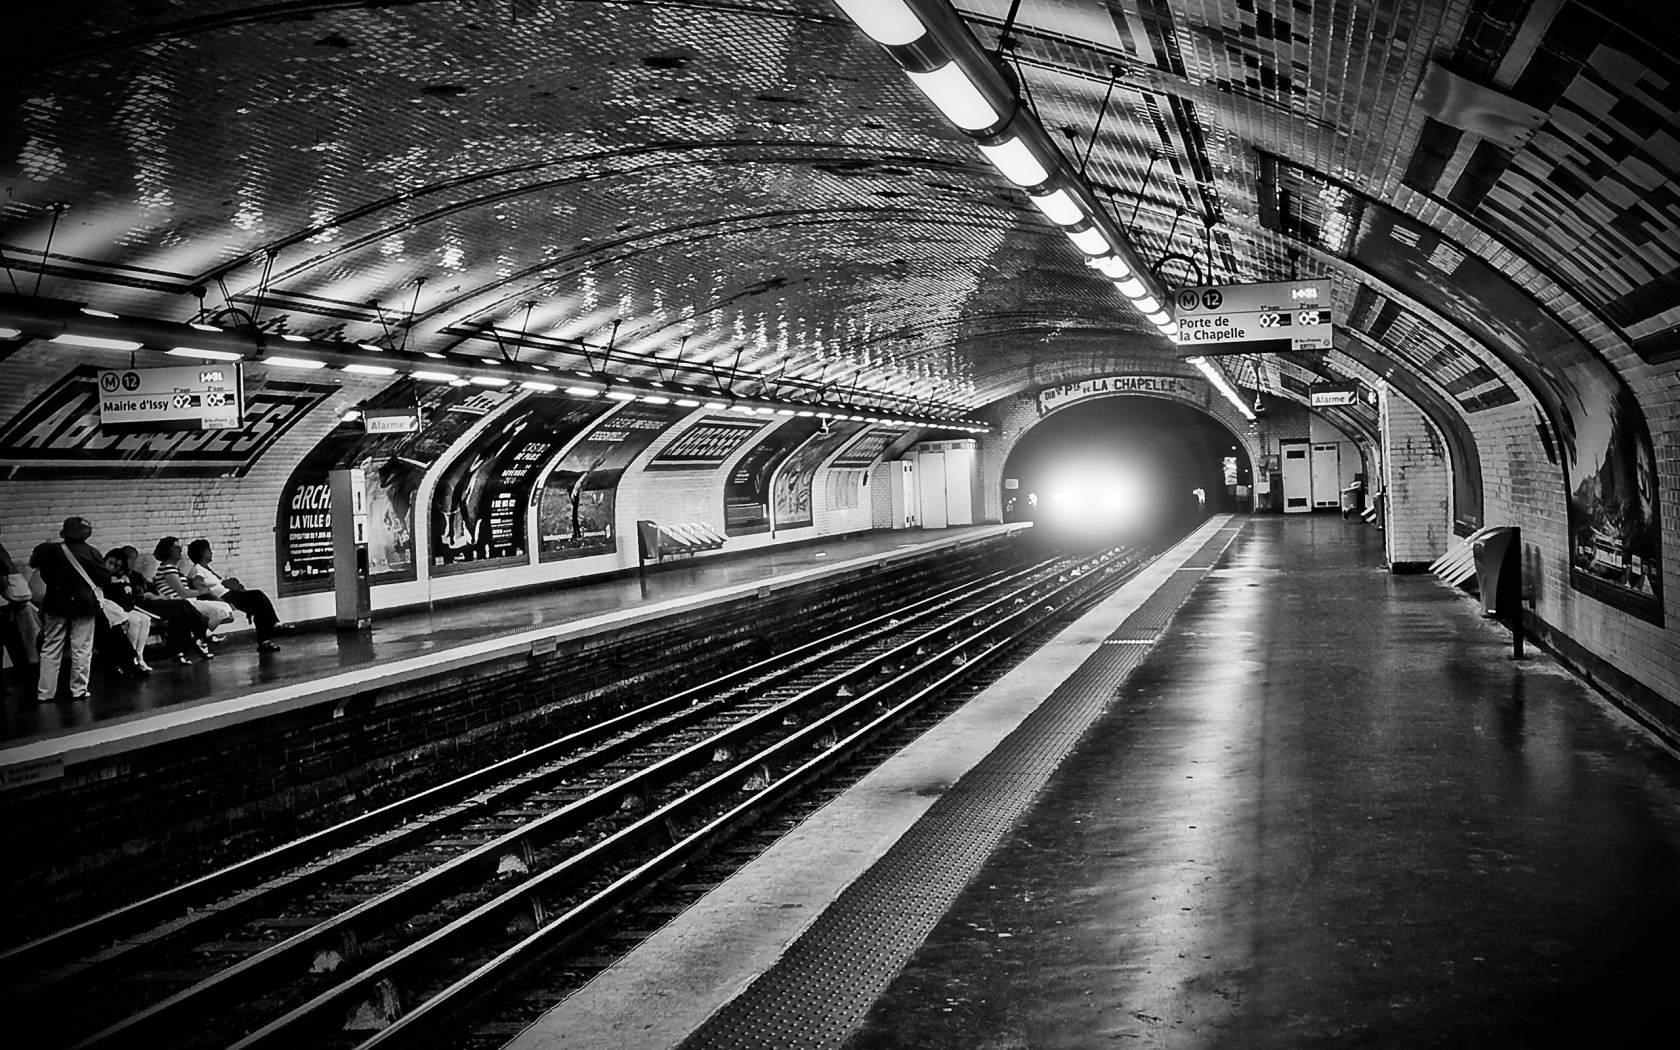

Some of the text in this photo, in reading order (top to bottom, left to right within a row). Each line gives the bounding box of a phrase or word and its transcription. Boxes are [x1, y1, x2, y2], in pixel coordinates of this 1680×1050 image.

[1204, 294, 1220, 306] 12
[1180, 317, 1229, 328] Porte de
[1260, 314, 1280, 328] 02
[1299, 311, 1320, 325] 05
[1180, 328, 1245, 341] la Chapelle
[124, 377, 138, 387] 12
[1093, 379, 1108, 391] LA
[1114, 378, 1177, 393] CHAPELLE
[103, 399, 169, 412] Mairie d'Issy
[174, 395, 191, 408] 02
[208, 394, 225, 407] 05
[371, 420, 405, 430] Alarme
[661, 427, 753, 456] ABBESSES
[292, 485, 332, 509] aRCH
[290, 515, 300, 529] LA
[302, 514, 325, 528] VILLE
